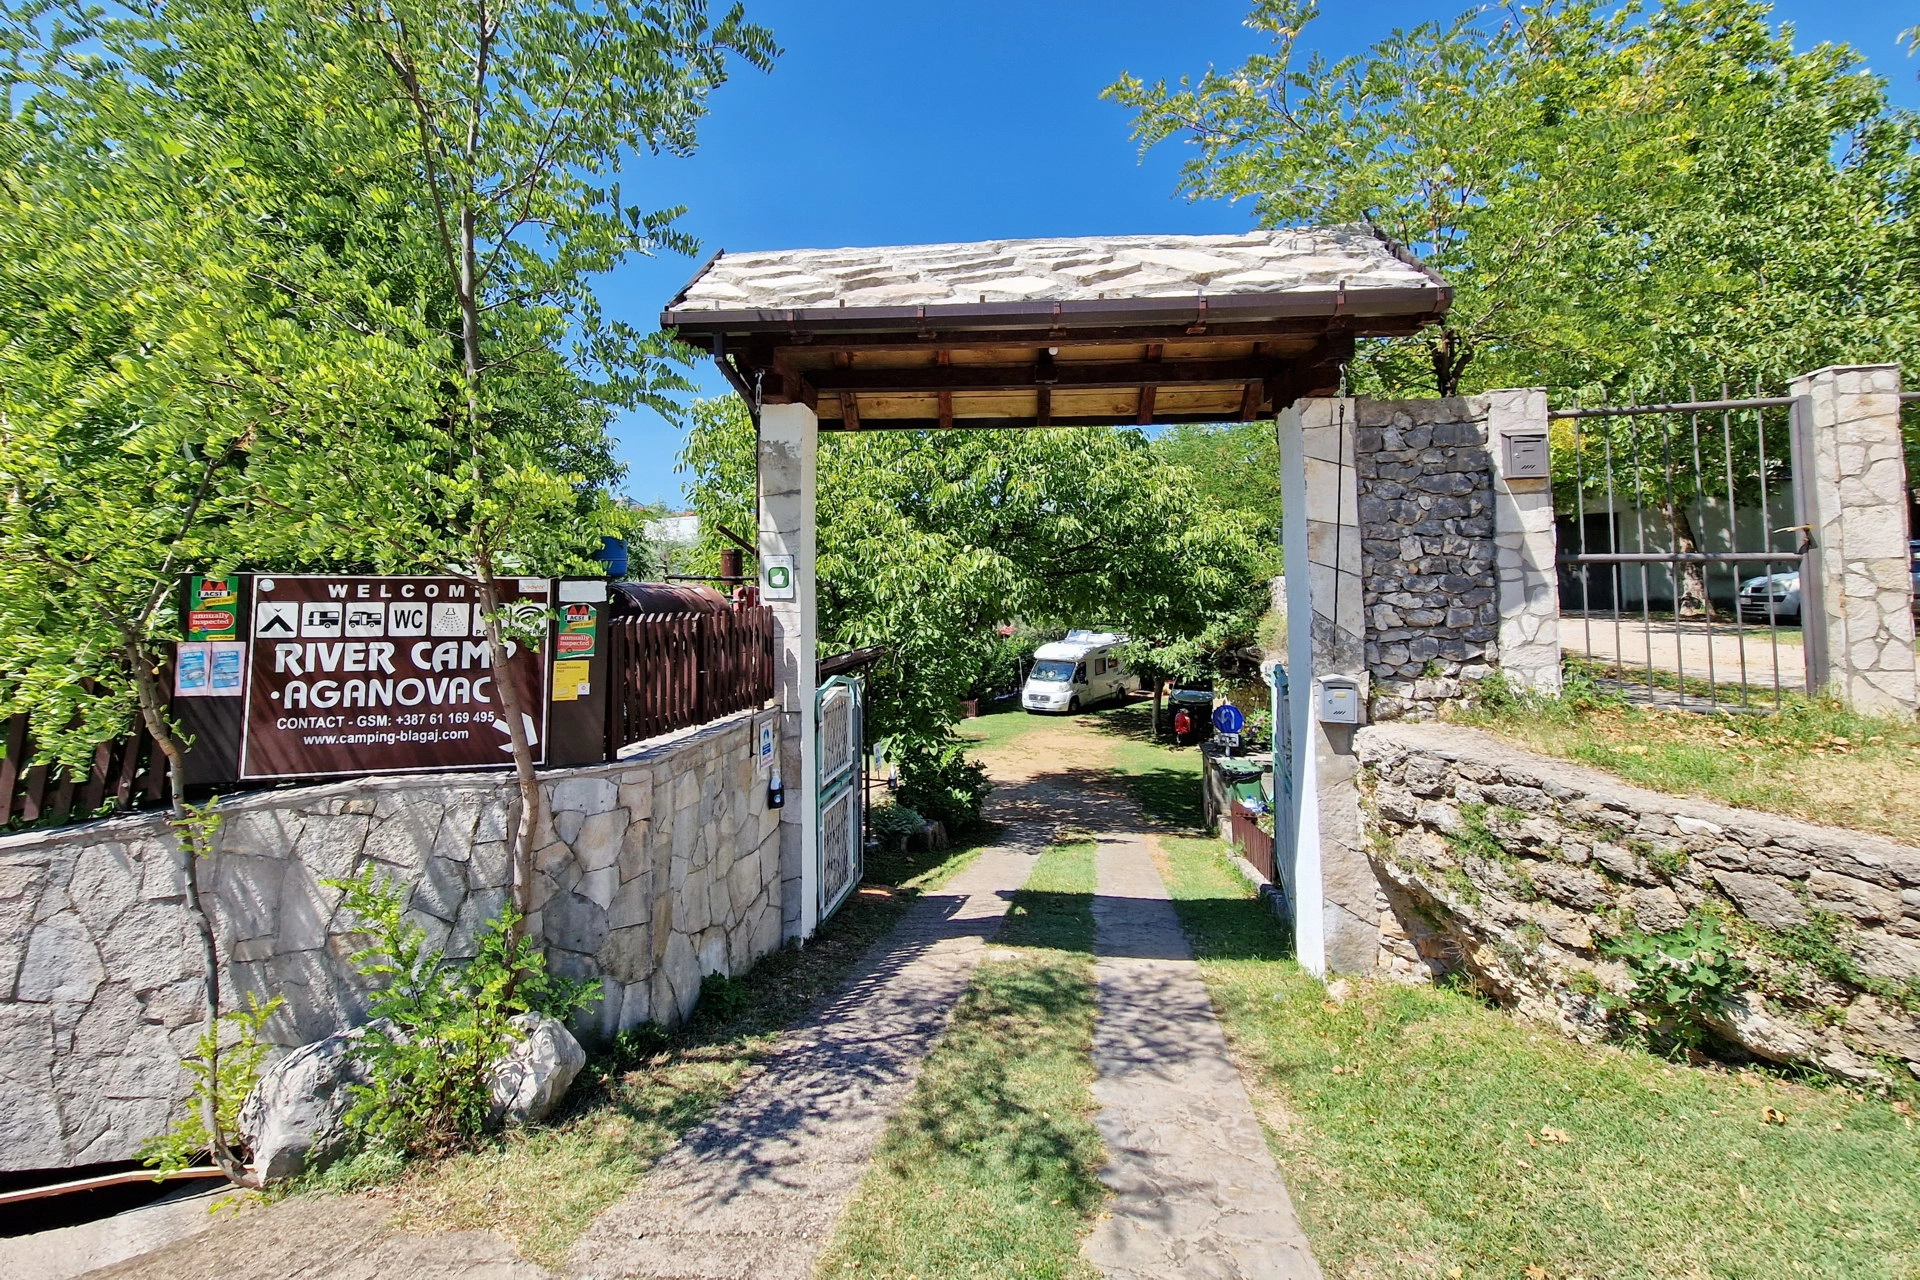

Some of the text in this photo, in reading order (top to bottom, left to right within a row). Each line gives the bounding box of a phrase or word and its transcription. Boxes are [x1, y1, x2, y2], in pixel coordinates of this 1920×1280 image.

[192, 612, 230, 620] annually
[394, 609, 424, 629] WC
[275, 641, 397, 677] RIVER
[276, 716, 345, 730] CONTACT
[356, 714, 392, 727] GSM:
[395, 713, 426, 726] +387
[429, 713, 443, 725] 61
[448, 712, 469, 724] 169
[473, 711, 495, 723] 495
[303, 728, 469, 745] www.camping-blagaj.com
